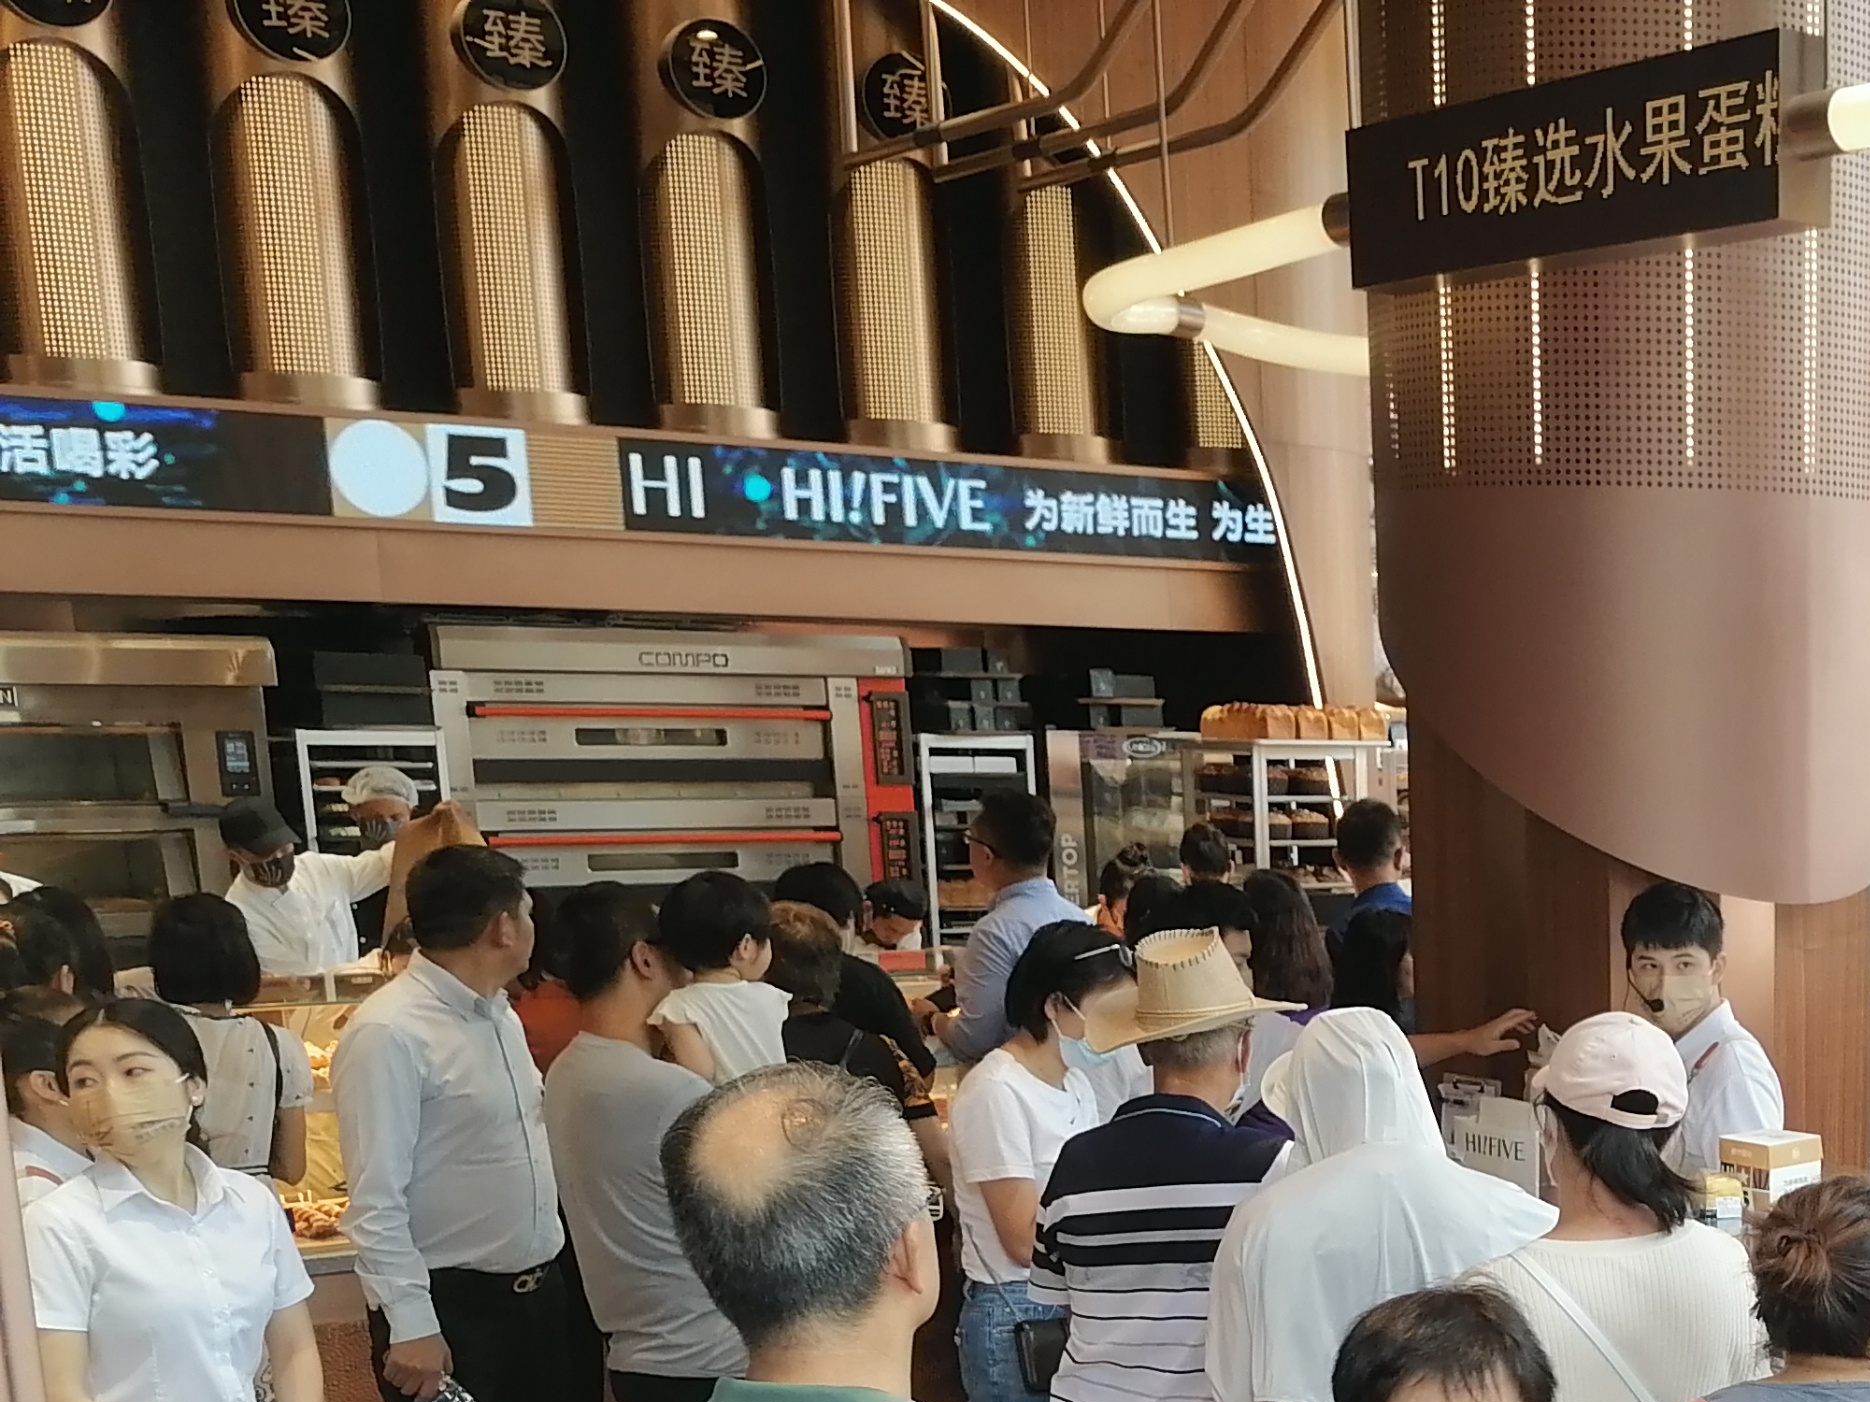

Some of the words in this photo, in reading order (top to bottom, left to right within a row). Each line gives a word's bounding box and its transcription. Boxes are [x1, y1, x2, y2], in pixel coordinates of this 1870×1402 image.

[483, 9, 549, 69] 臻
[688, 39, 749, 99] 臻
[444, 433, 518, 512] 5
[628, 452, 705, 519] HI
[780, 465, 993, 532] HI!FIVE
[1023, 488, 1198, 541] 为新鲜而生
[1210, 500, 1277, 545] 为生
[638, 651, 730, 668] COMPO
[1465, 1132, 1526, 1162] HI!FIVE
